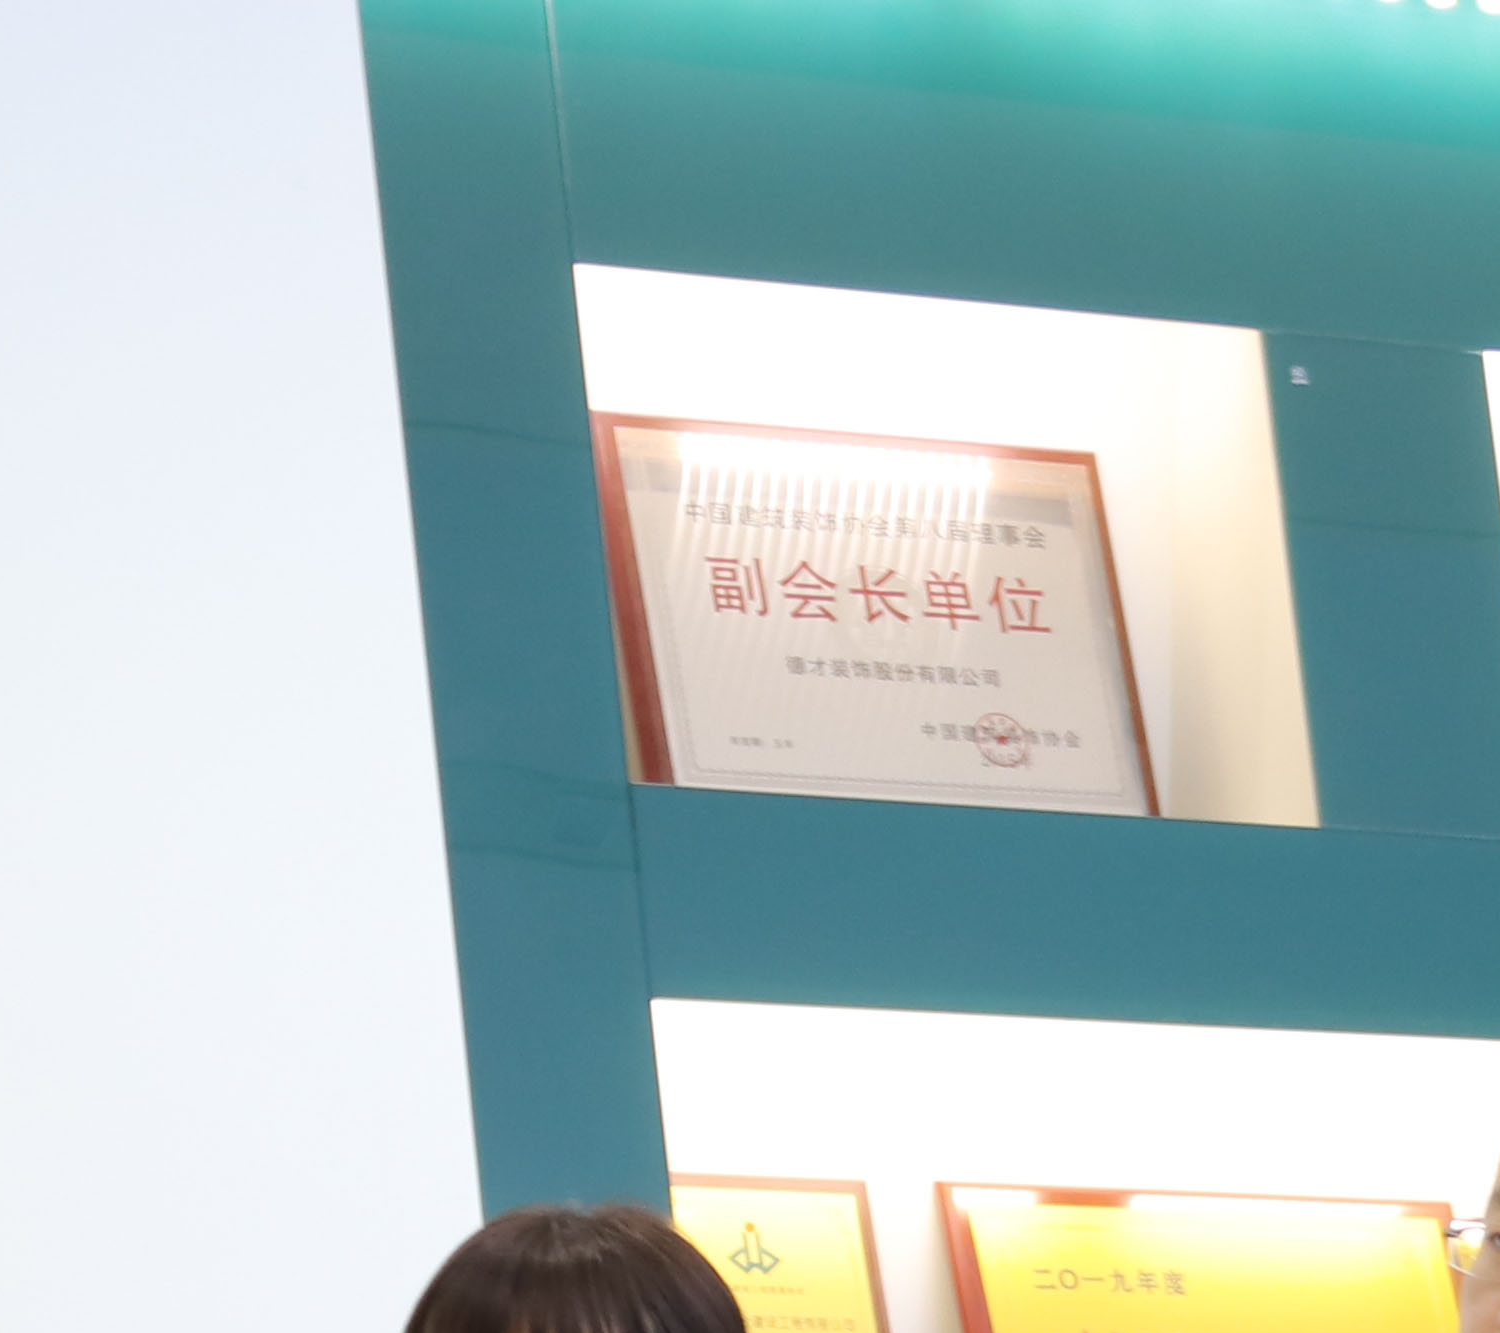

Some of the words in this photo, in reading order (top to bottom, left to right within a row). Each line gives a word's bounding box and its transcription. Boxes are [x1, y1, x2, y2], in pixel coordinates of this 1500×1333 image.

[704, 556, 1052, 634] 副会长单位
